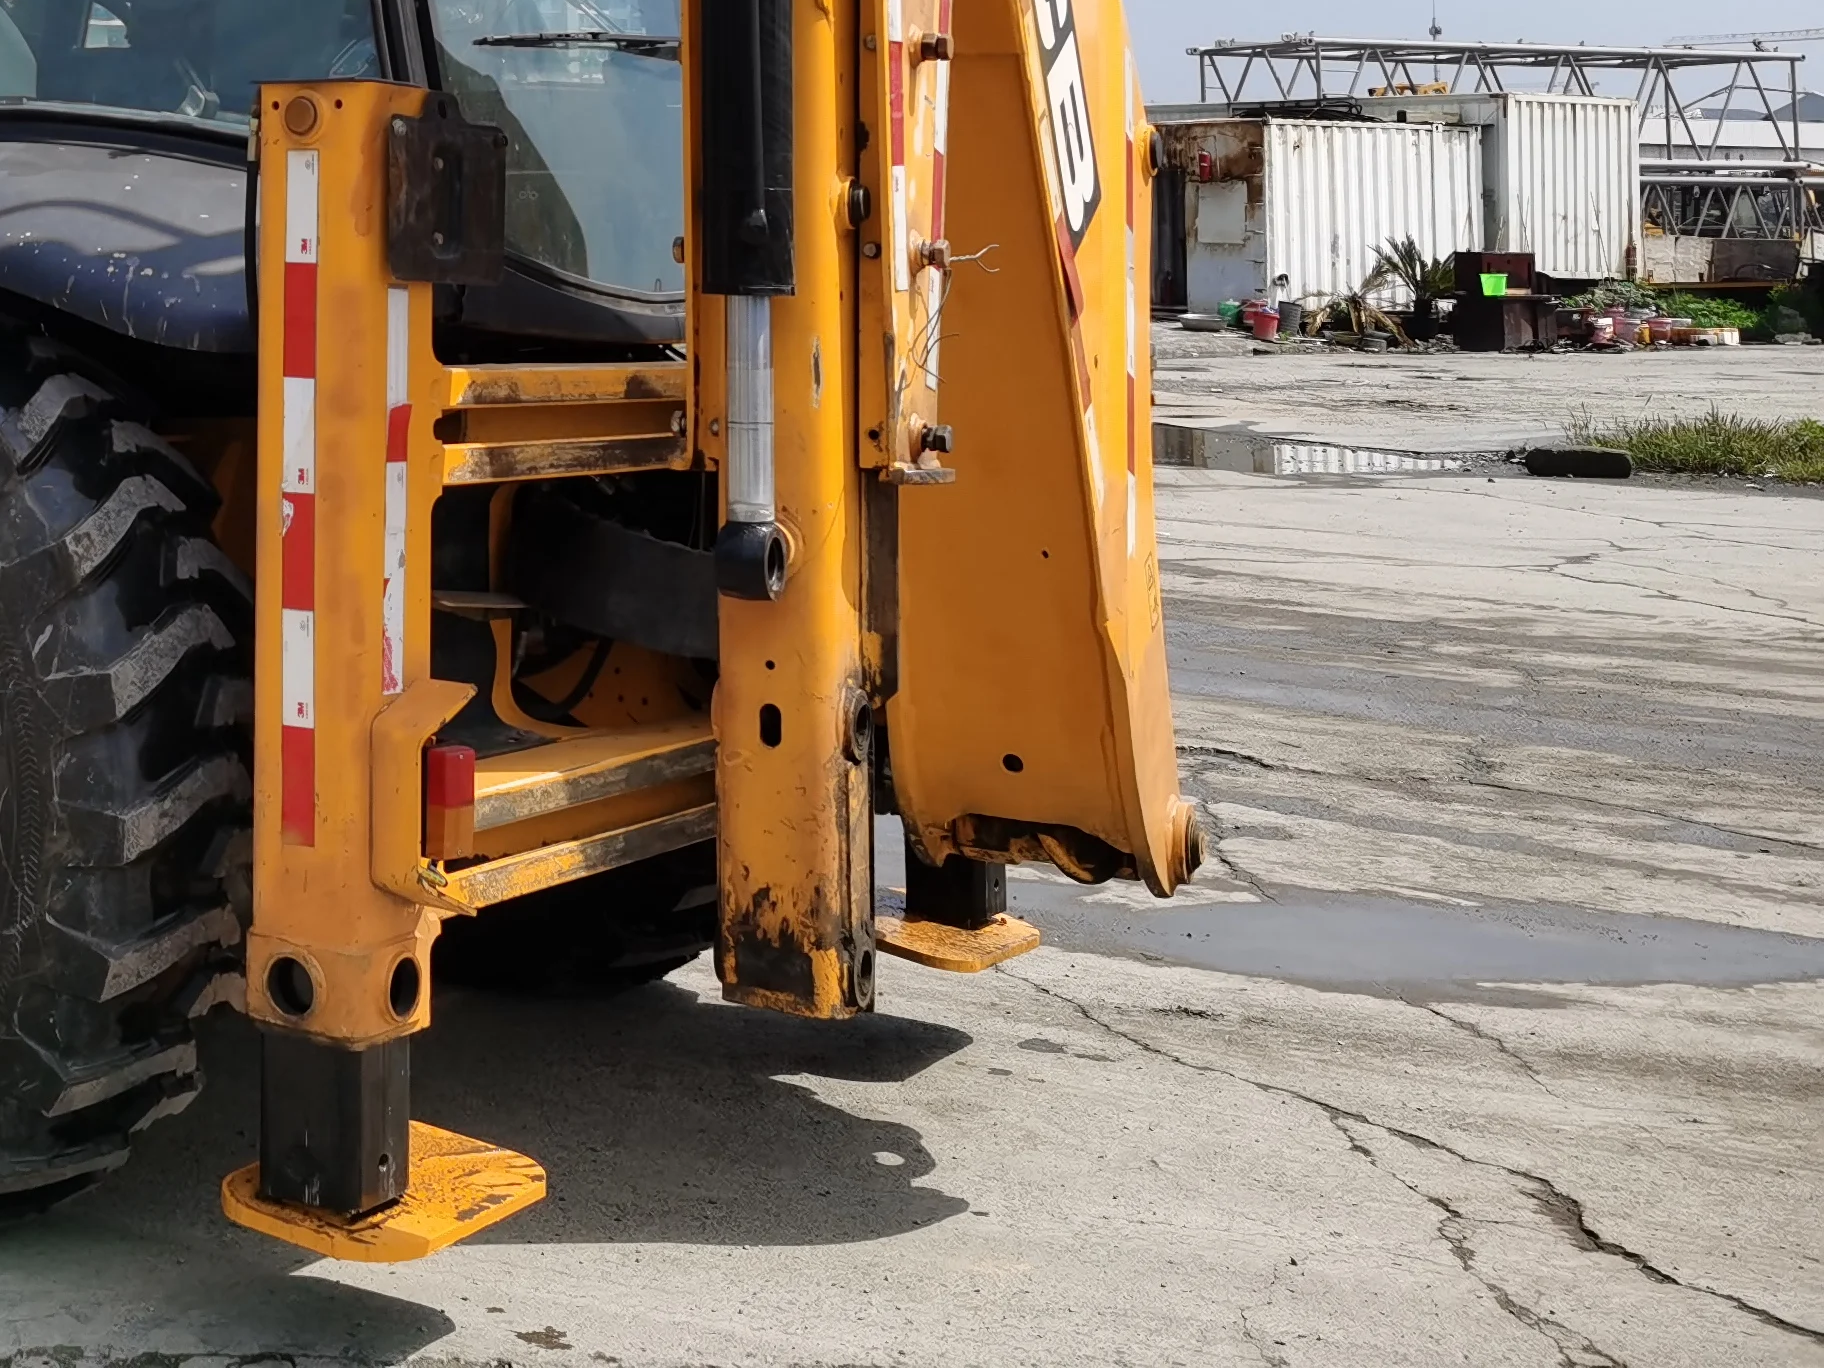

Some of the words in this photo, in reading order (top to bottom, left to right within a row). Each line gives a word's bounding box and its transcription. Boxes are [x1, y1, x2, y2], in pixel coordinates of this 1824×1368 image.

[300, 238, 308, 255] 3M
[297, 468, 305, 486] 3M
[297, 702, 305, 719] 3M
